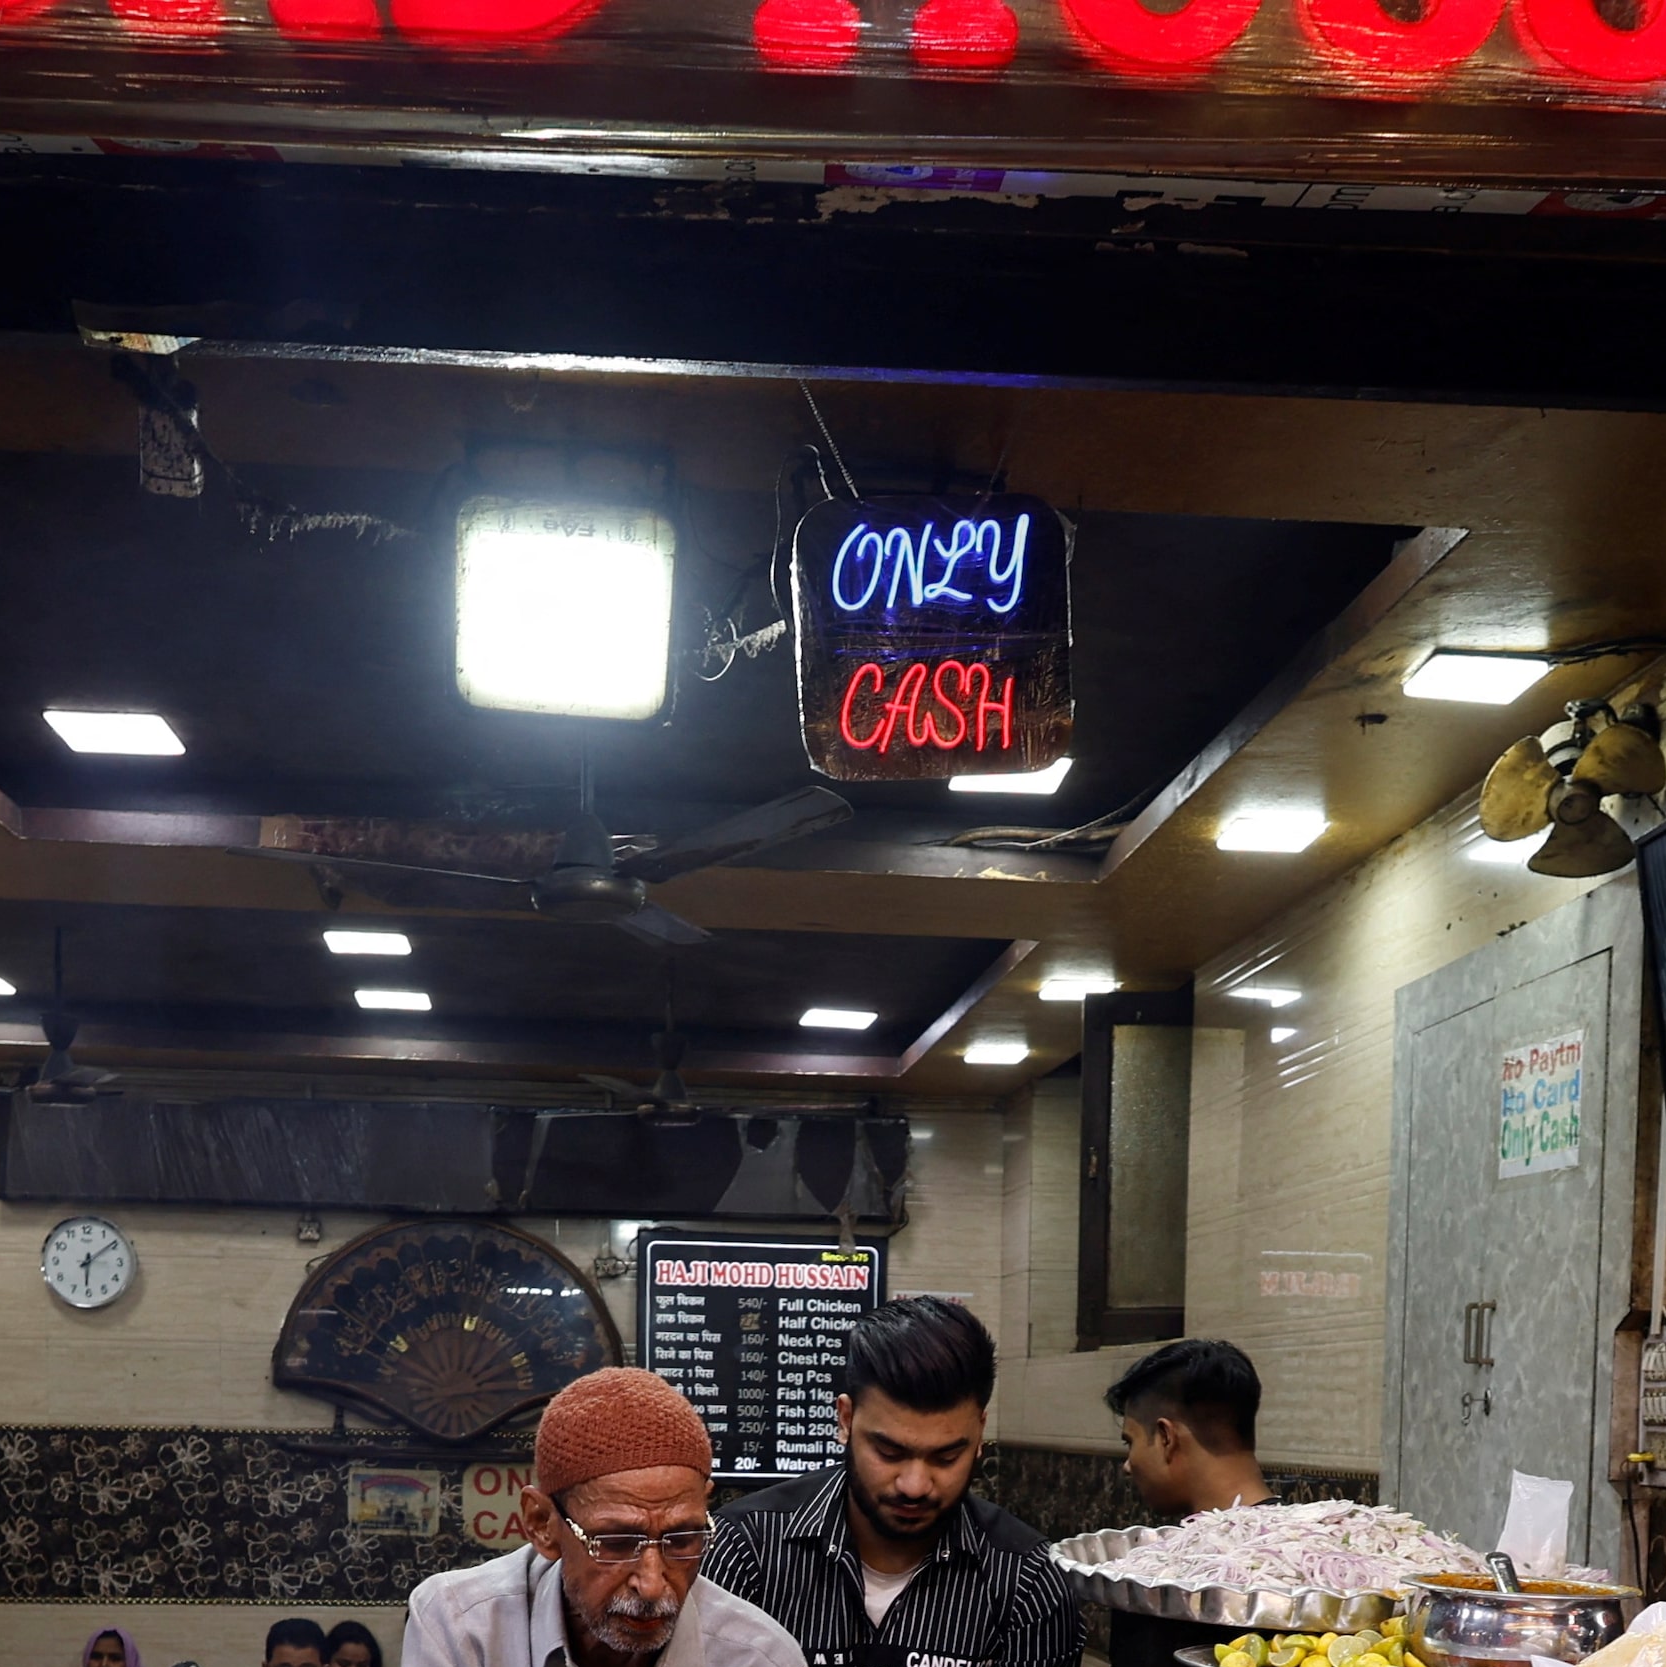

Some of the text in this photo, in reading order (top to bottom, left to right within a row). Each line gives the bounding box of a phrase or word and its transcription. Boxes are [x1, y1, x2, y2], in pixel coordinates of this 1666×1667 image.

[833, 513, 1030, 613] ONLY
[839, 660, 1015, 754] CASH
[1529, 1041, 1581, 1076] Paytm
[1502, 1069, 1581, 1118] No Card
[1501, 1104, 1579, 1167] Only Cash
[655, 1259, 869, 1291] HAJI MOHD HUSSAIN
[778, 1298, 862, 1313] Full Chicken
[778, 1315, 807, 1330] Half
[809, 1316, 858, 1331] Chicke
[741, 1333, 770, 1346] 160/-
[778, 1333, 842, 1348] Neck Pcs
[740, 1351, 769, 1364] 160/-
[778, 1352, 847, 1366] Chest Pcs
[740, 1369, 769, 1382] 140/-
[778, 1369, 833, 1385] Leg Pcs
[737, 1388, 770, 1401] 1000/-
[776, 1388, 807, 1401] Fish
[737, 1405, 770, 1418] 500/-
[776, 1405, 807, 1419] Fish
[738, 1421, 771, 1435] 250/-
[776, 1422, 807, 1436] Fish
[776, 1440, 823, 1454] Rumali
[734, 1456, 762, 1471] 20/-
[775, 1456, 822, 1471] Watrer
